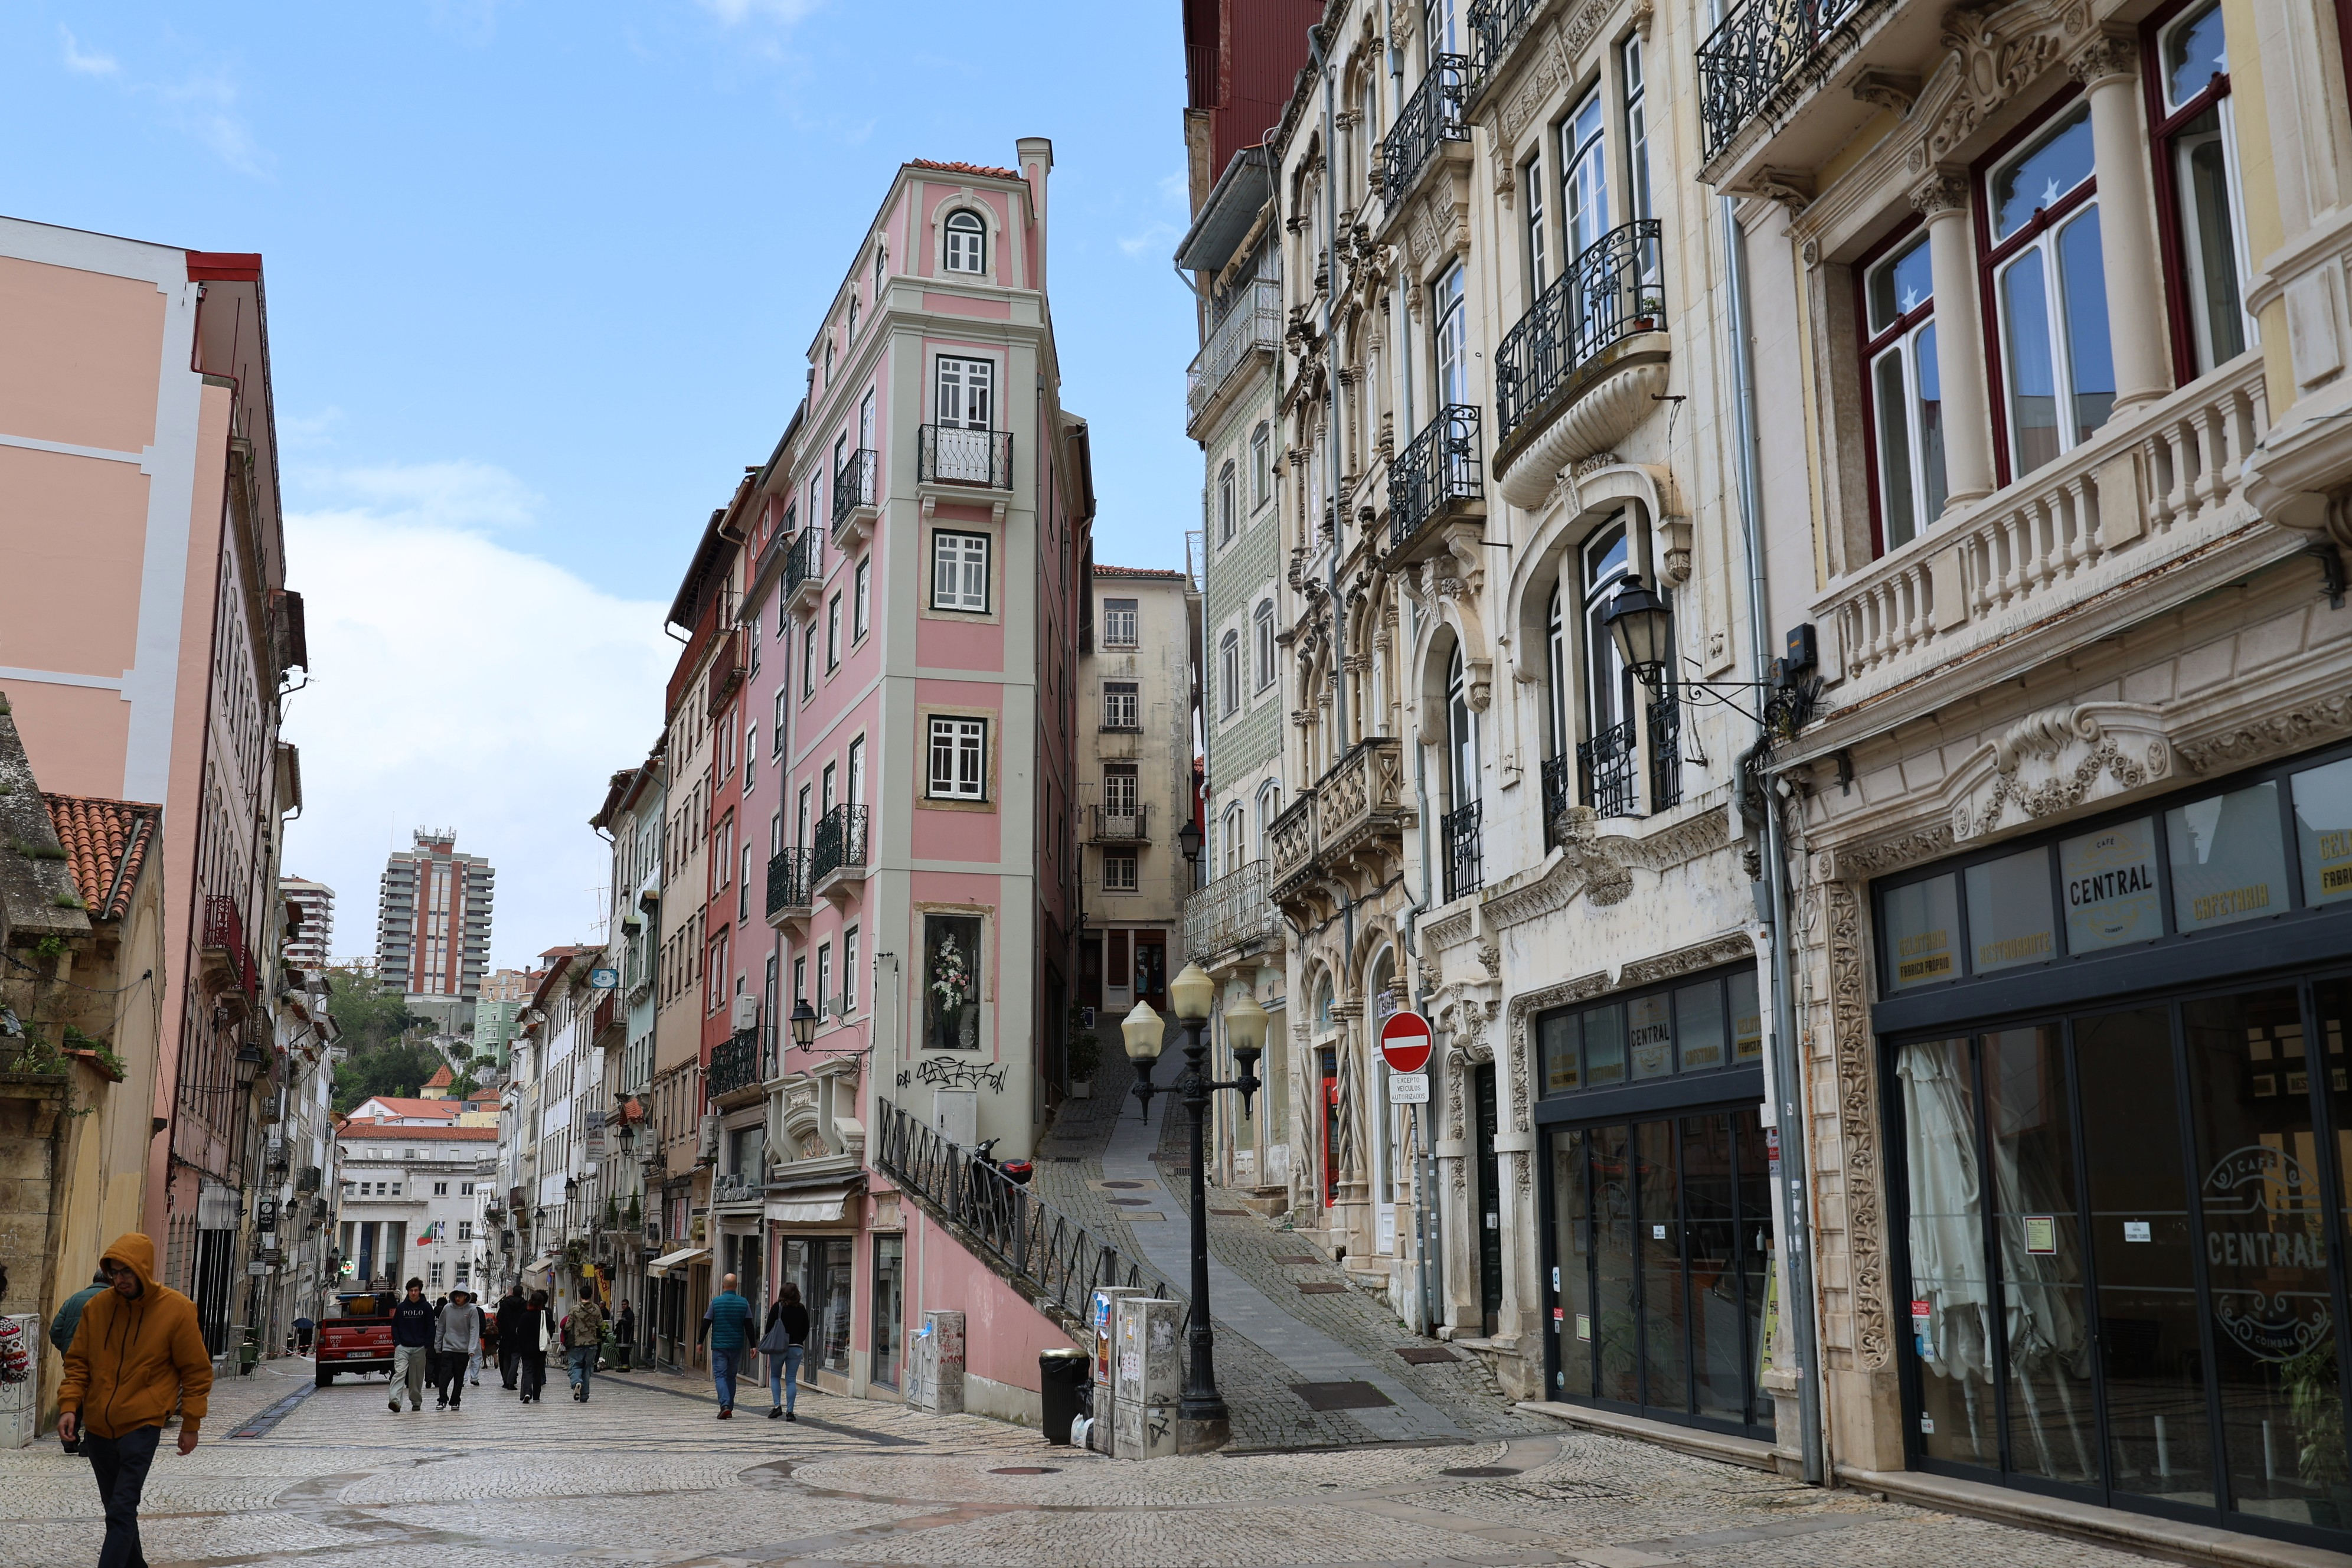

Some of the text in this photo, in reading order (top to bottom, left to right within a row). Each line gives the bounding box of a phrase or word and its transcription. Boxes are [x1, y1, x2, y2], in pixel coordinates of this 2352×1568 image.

[2097, 837, 2115, 848] CAFÉ
[2070, 864, 2153, 906] CENTRAL
[2193, 883, 2269, 921] CAFETARIA
[1898, 930, 1947, 957] GELATARIA
[1979, 931, 2051, 964] RESTAURANTE
[1900, 956, 1949, 978] FABRICO PRÓPRIO
[1631, 1023, 1670, 1047] CENTRAL
[2237, 1155, 2275, 1172] CAFÉ
[2207, 1231, 2327, 1268] CENTRAL
[2255, 1335, 2295, 1348] COIMBRA
